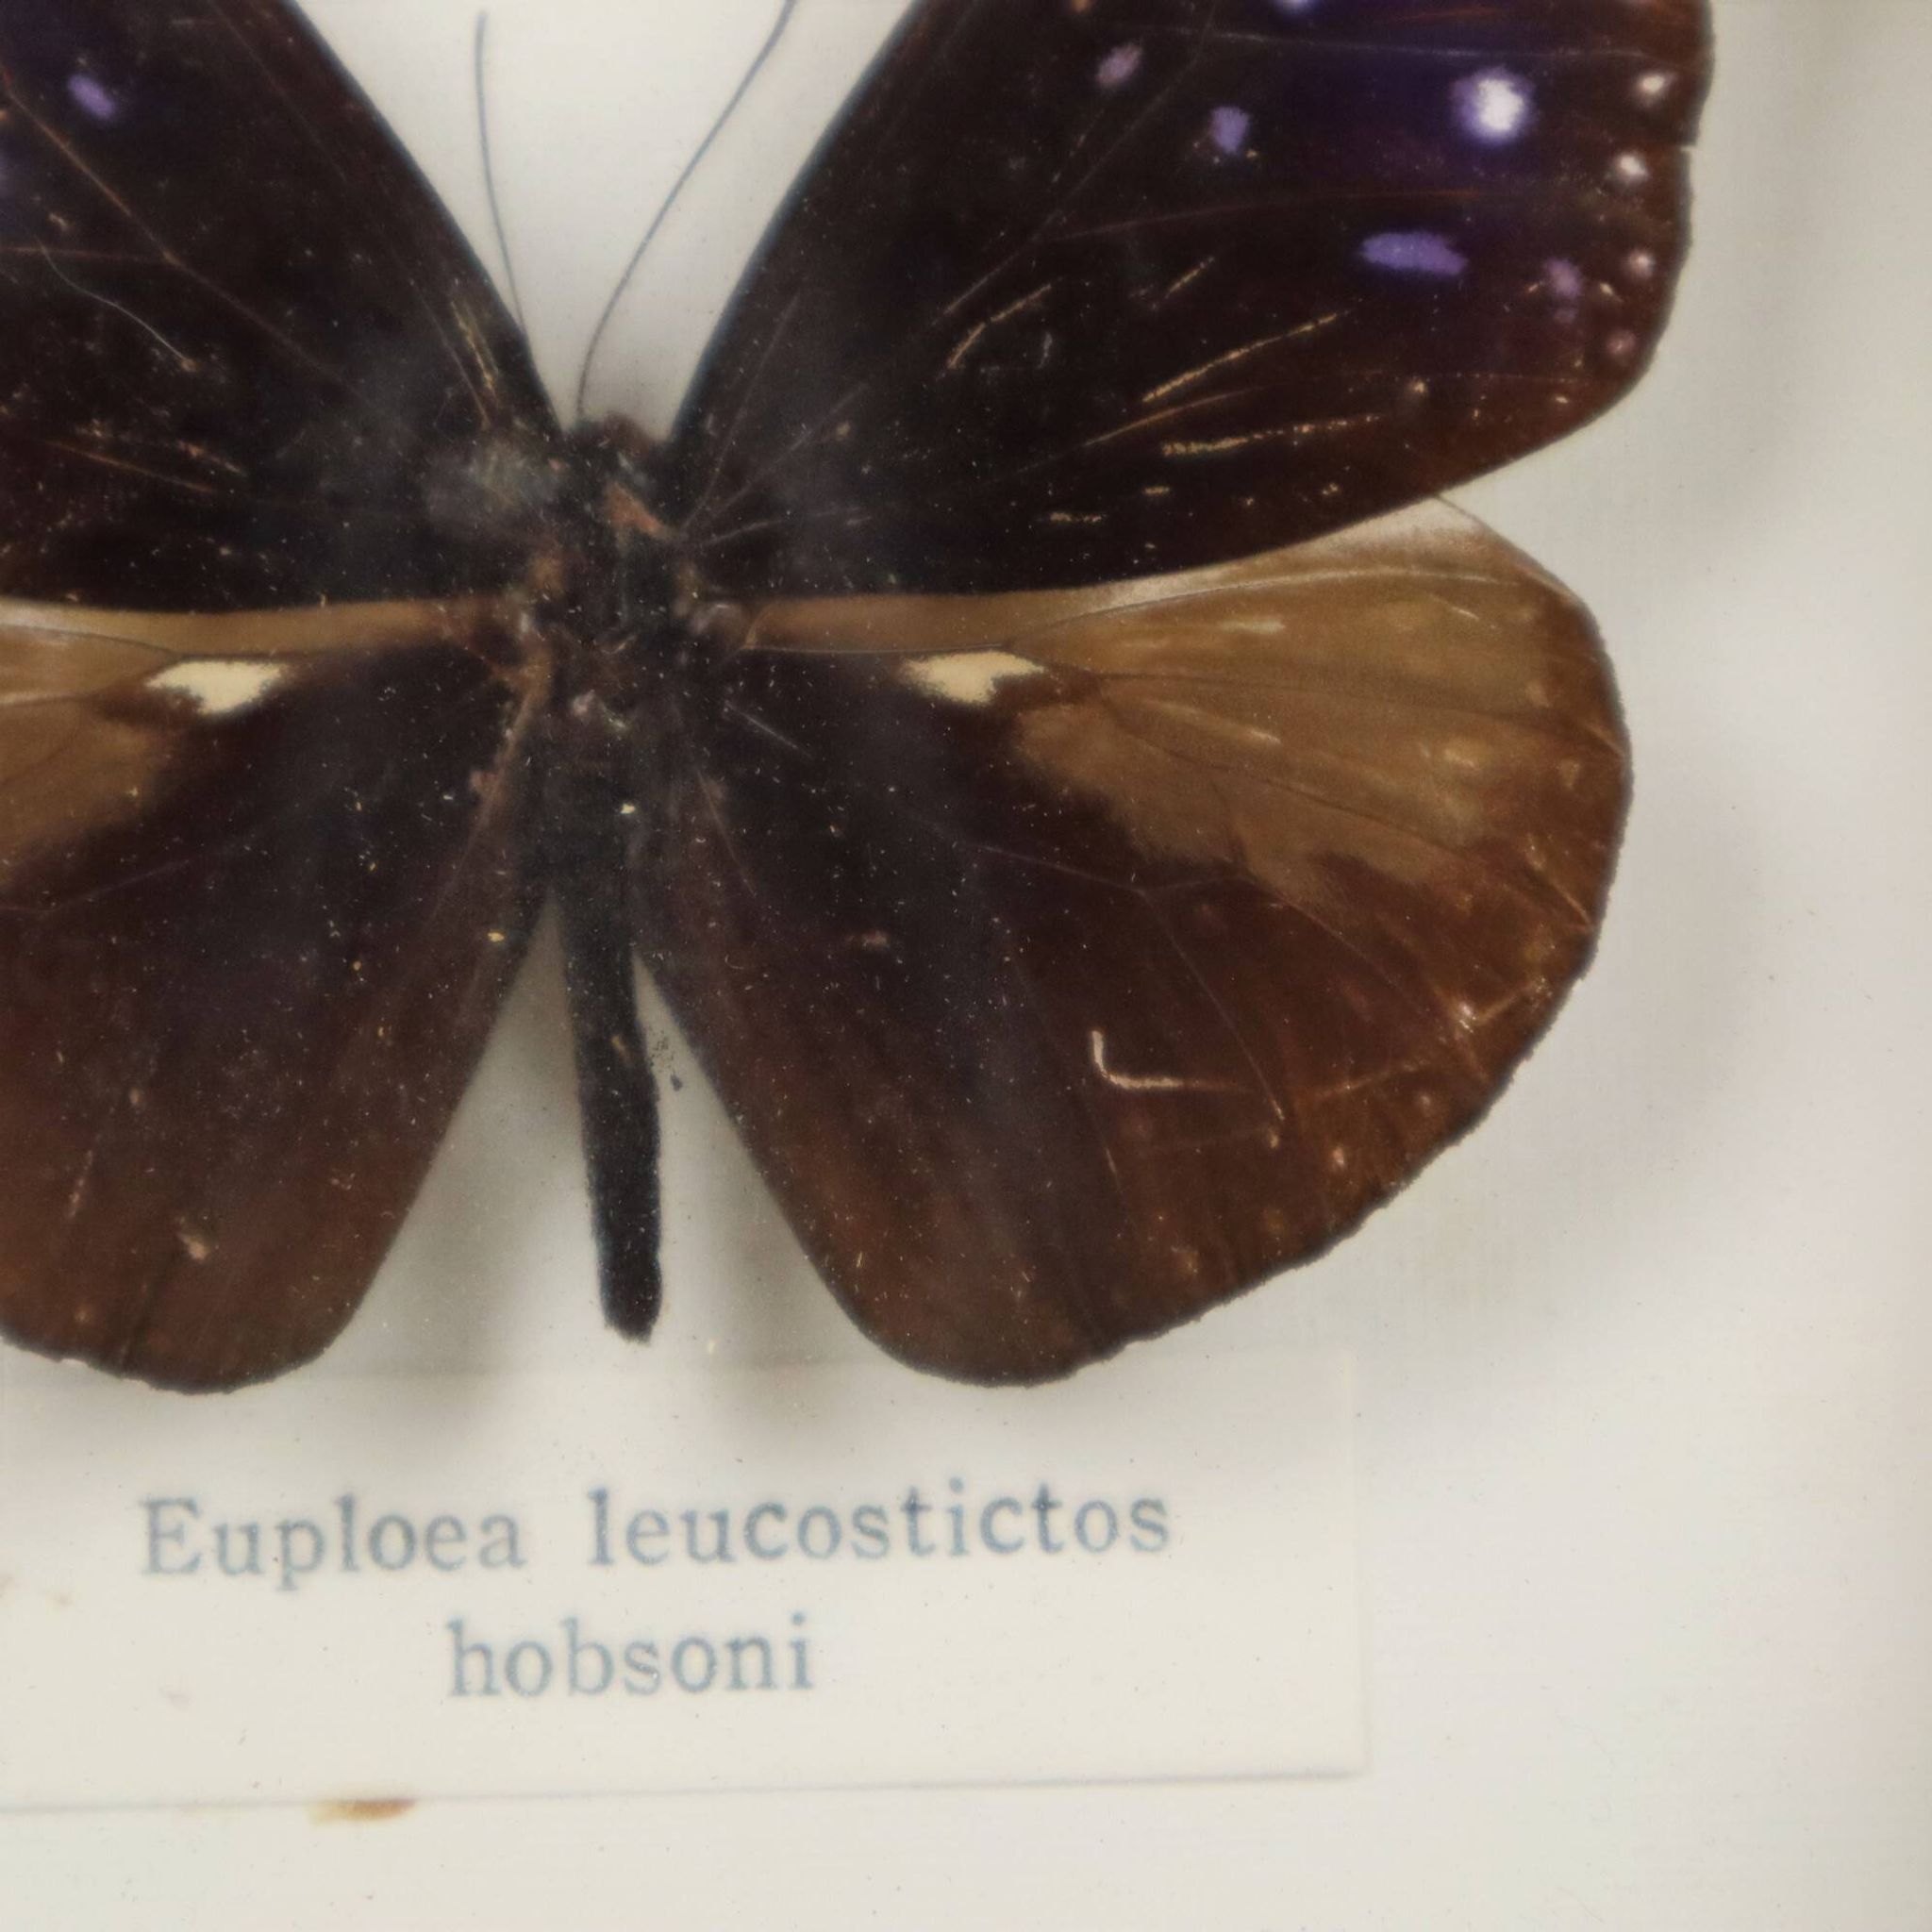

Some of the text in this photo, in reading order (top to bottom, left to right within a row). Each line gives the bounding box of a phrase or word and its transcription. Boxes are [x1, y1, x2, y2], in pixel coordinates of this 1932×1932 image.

[139, 1478, 1171, 1592] Euploea leucostictos
[445, 1612, 816, 1698] hobsoni
